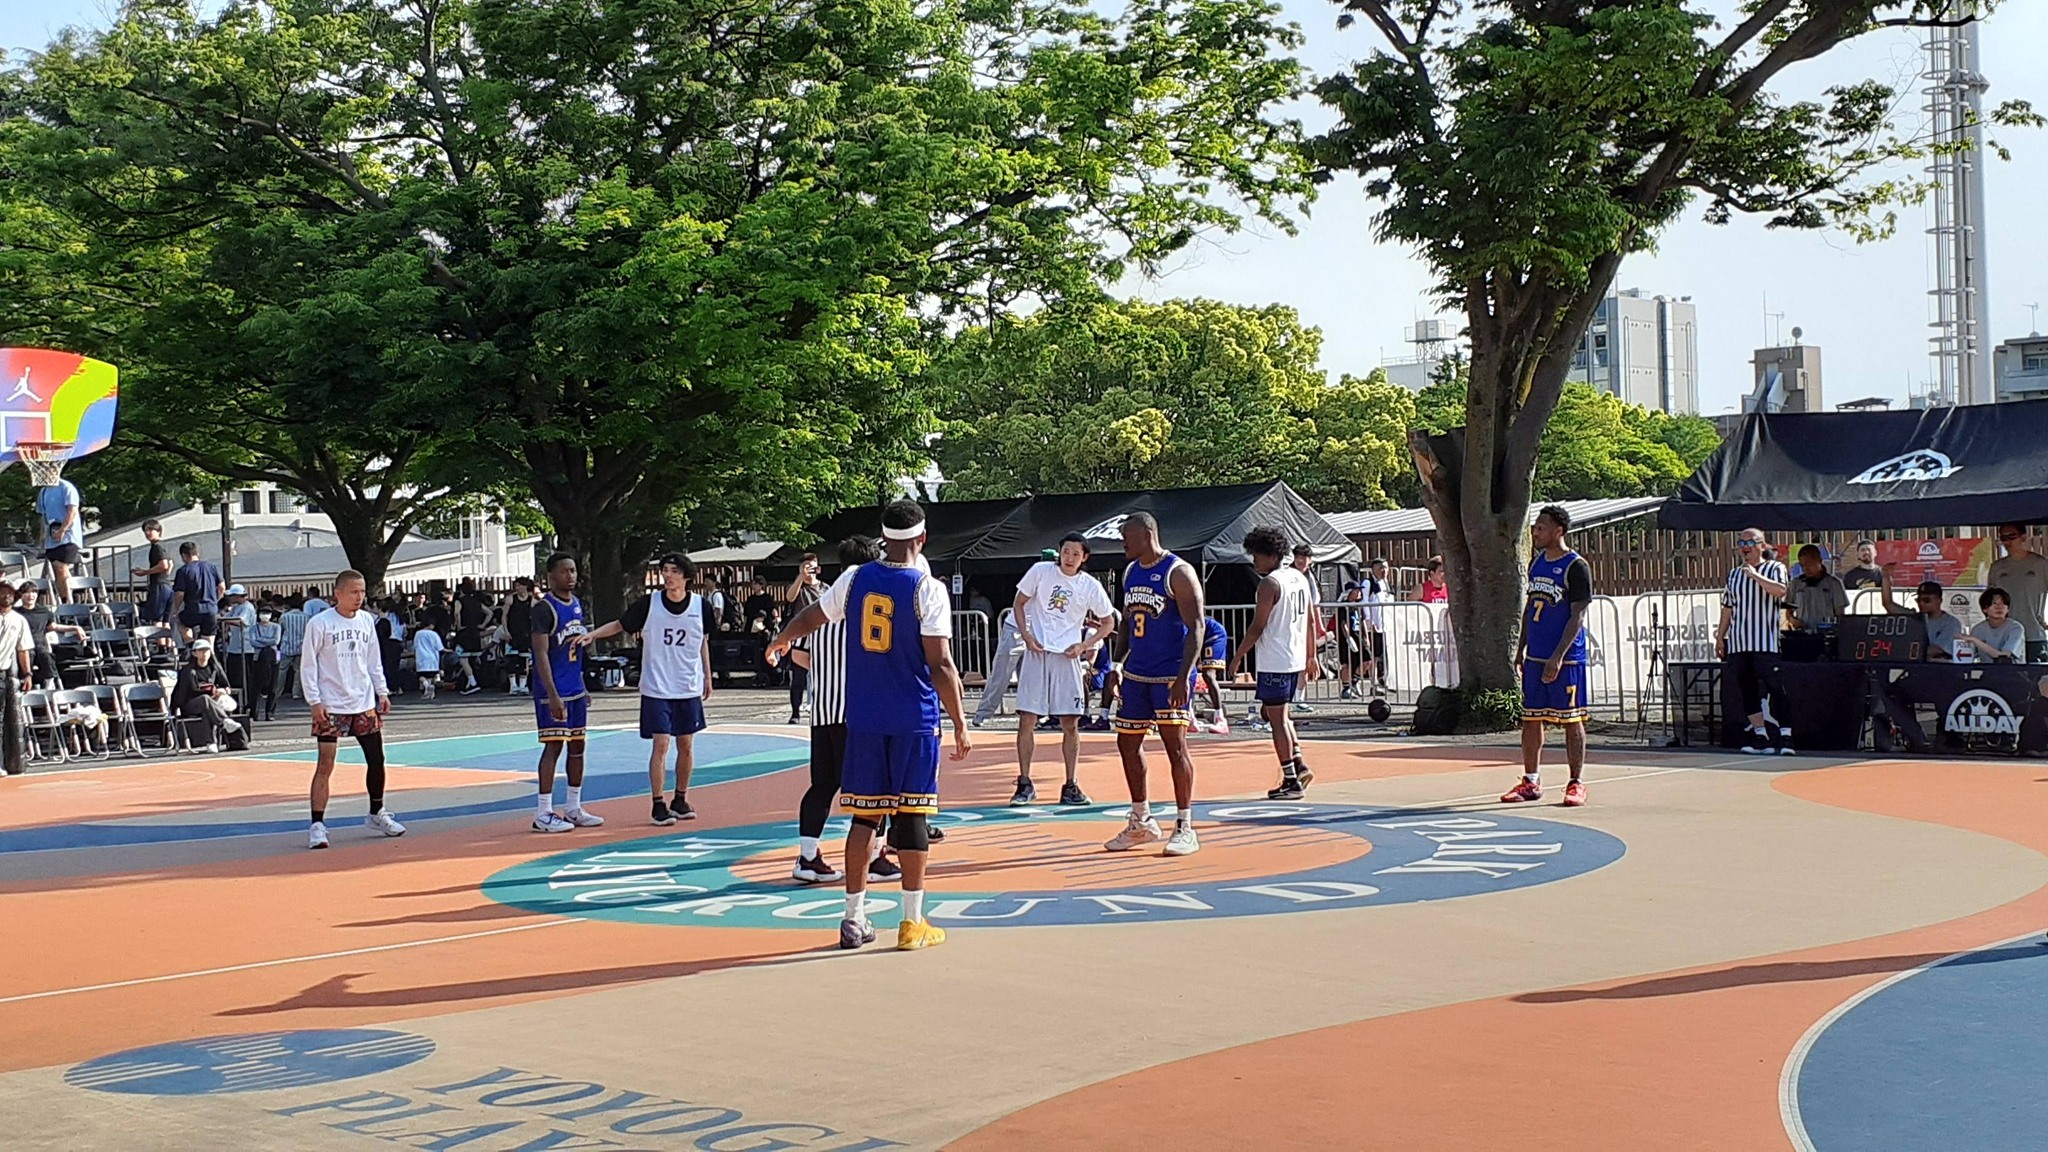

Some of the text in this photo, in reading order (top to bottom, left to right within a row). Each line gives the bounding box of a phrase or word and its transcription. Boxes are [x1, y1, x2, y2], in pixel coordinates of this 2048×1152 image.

[1530, 582, 1563, 603] ARRIORS
[1533, 600, 1544, 622] 7
[861, 592, 895, 653] 6
[1134, 613, 1145, 637] 3
[1867, 616, 1907, 635] 6:00
[332, 629, 368, 645] HIRYU
[663, 628, 686, 646] 52
[1855, 640, 1920, 660] 0 24 0
[1566, 684, 1577, 707] 7
[1945, 715, 2025, 734] ALLDAY
[1366, 817, 1562, 878] PARK
